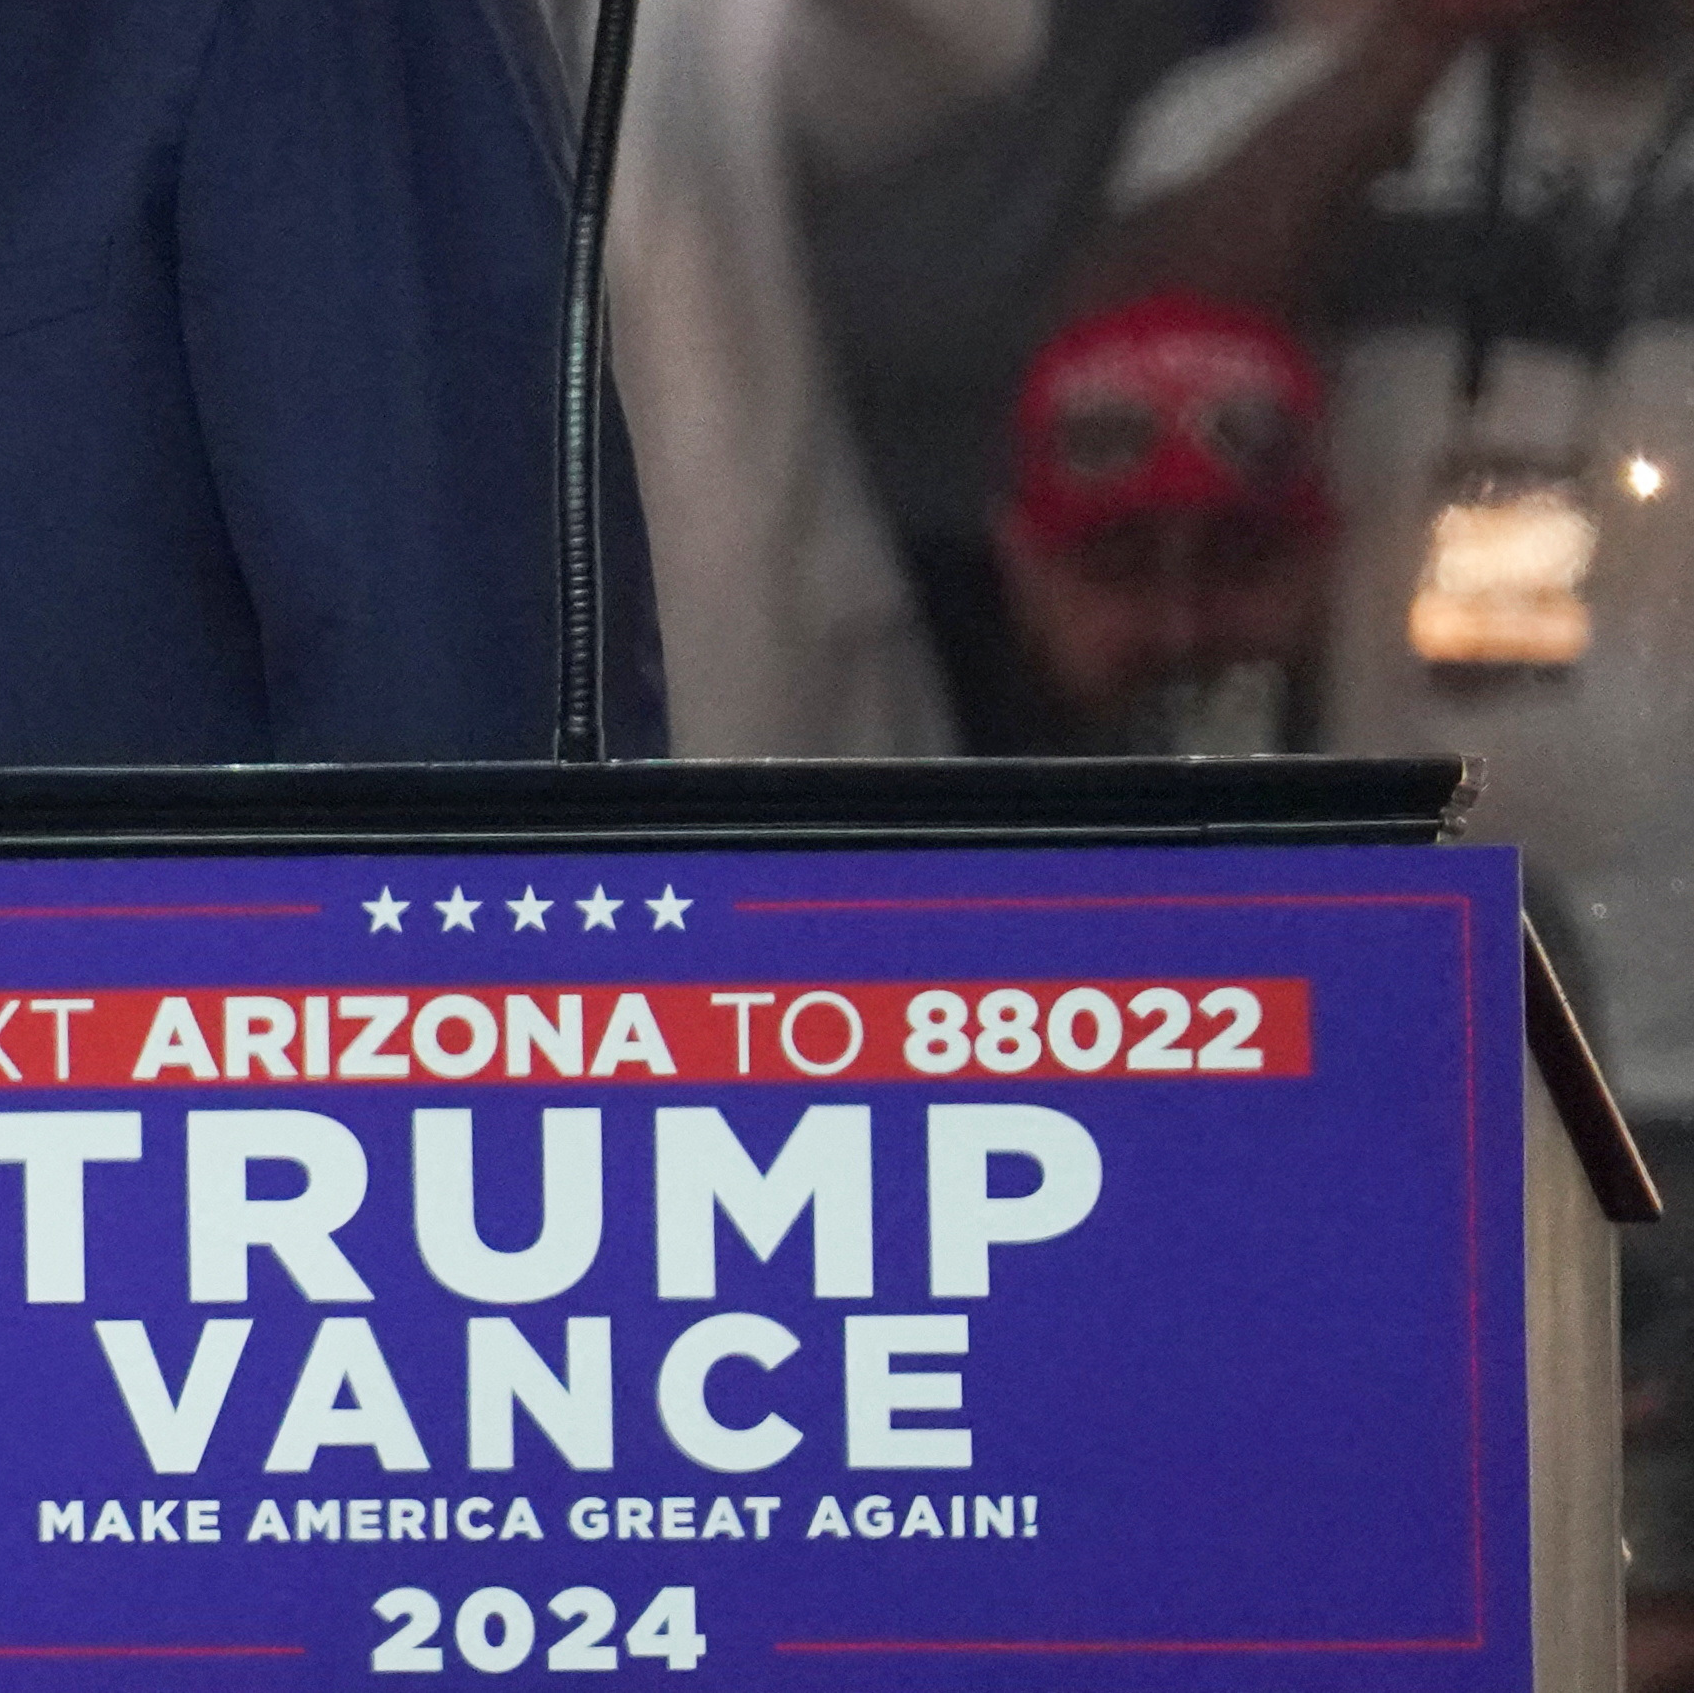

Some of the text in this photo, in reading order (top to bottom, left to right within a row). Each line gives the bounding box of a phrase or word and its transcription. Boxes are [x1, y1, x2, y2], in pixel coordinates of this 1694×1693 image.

[130, 991, 678, 1082] ARIZONA
[709, 989, 865, 1077] TO
[902, 985, 1264, 1075] 88022
[92, 1311, 974, 1475] VANCE
[38, 1493, 1039, 1544] MAKE AMERICA GREAT AGAIN!
[370, 1585, 708, 1675] 2024
